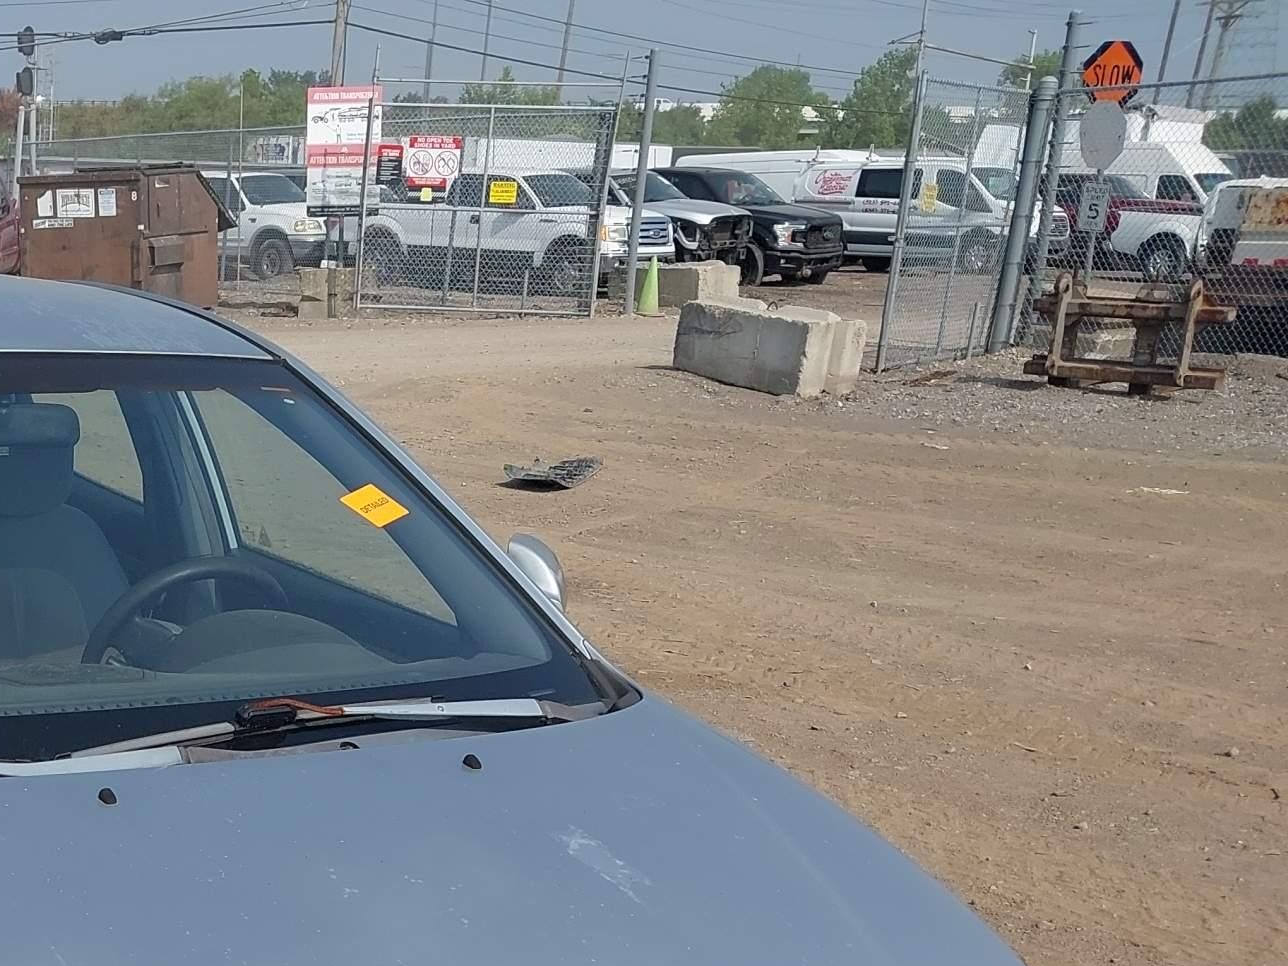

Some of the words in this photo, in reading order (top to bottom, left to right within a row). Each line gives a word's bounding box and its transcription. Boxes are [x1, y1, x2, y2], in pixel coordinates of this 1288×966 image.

[1093, 64, 1136, 87] SLOW
[309, 156, 338, 164] ATTENTION
[131, 191, 138, 201] 8
[1087, 203, 1099, 219] 5
[359, 496, 390, 514] DETAILED
